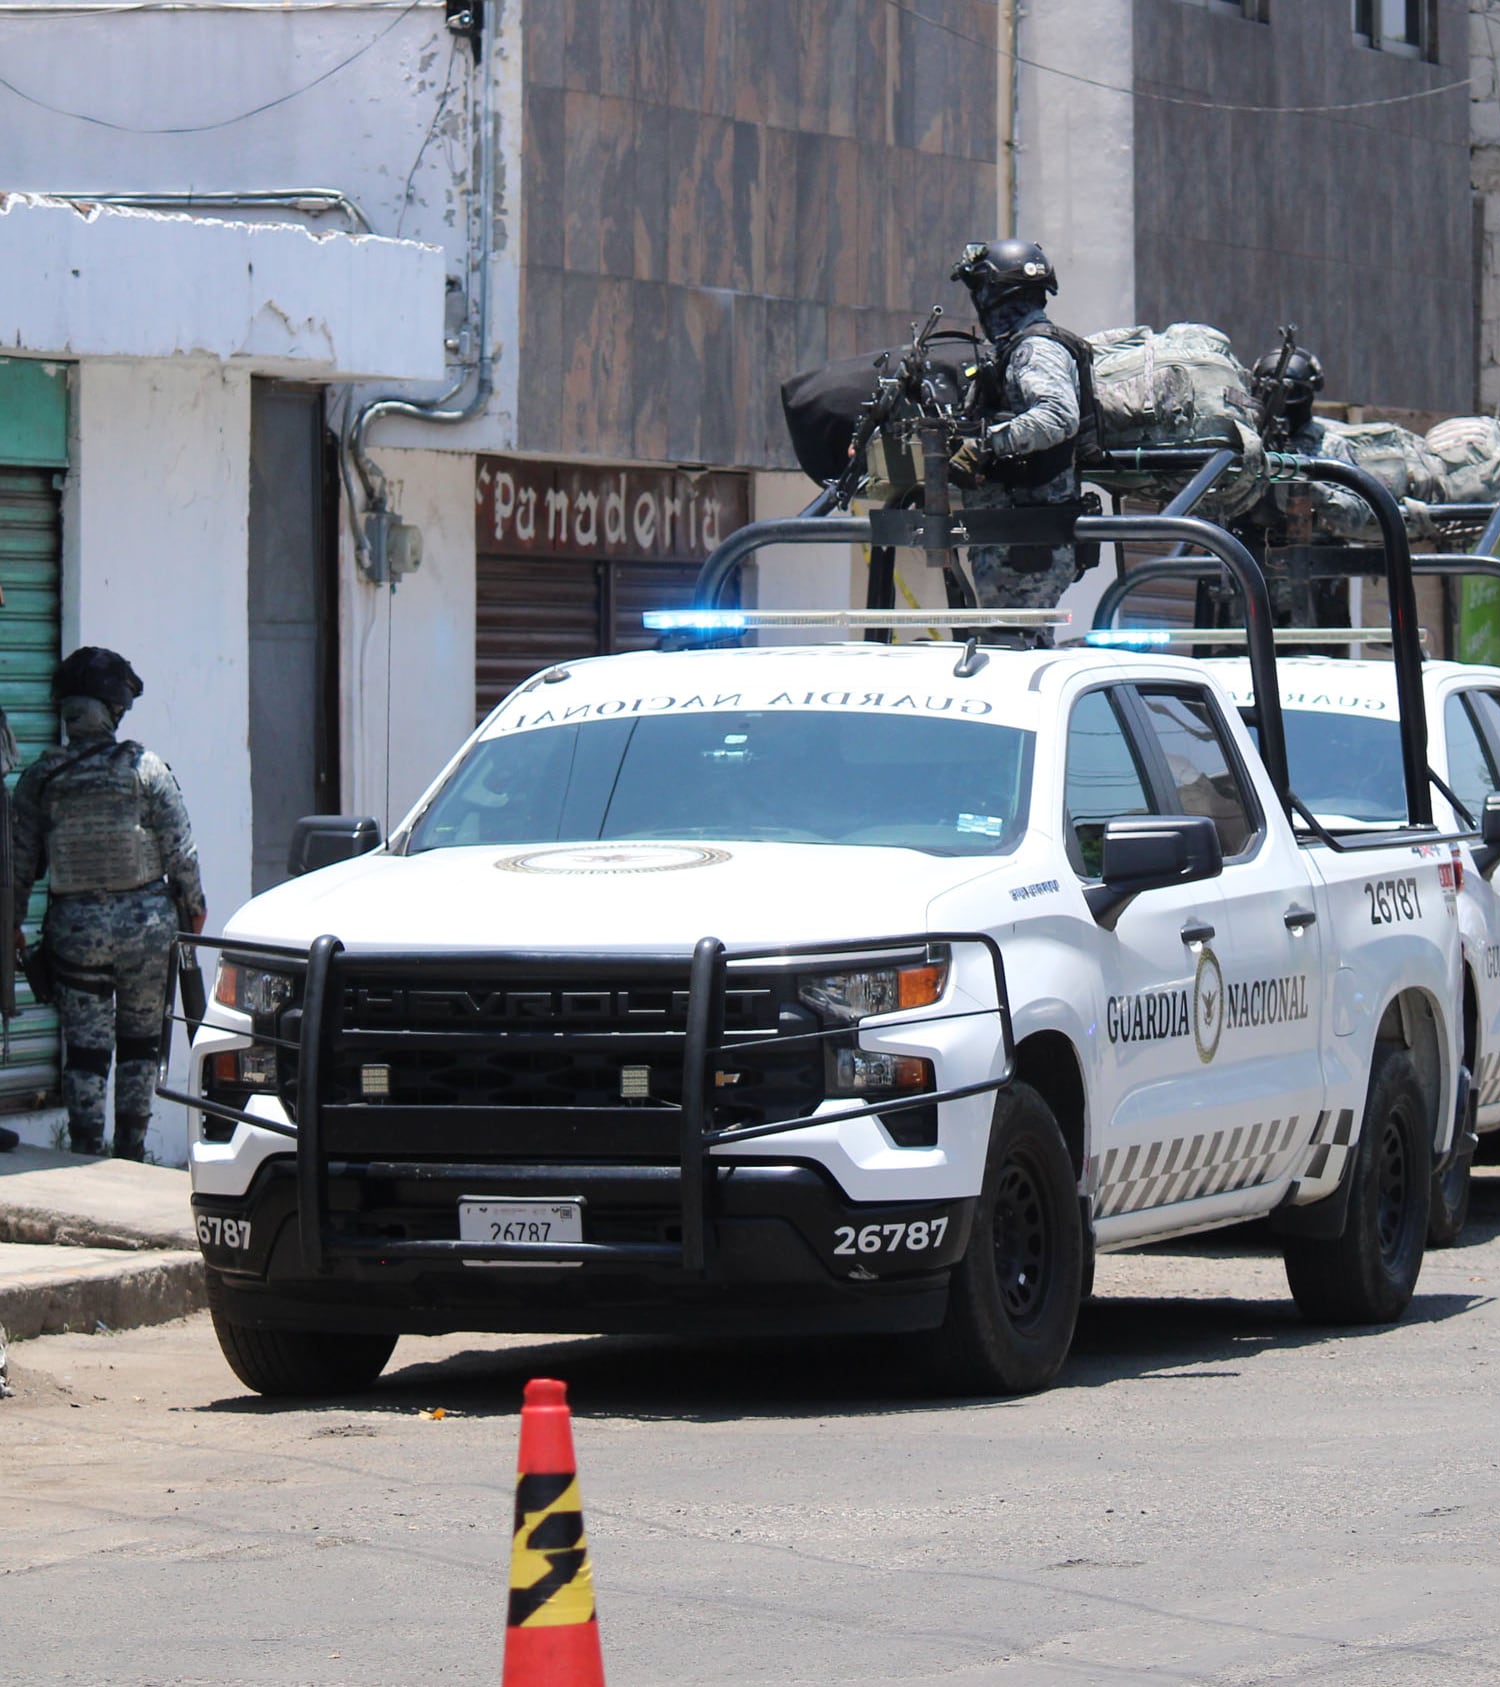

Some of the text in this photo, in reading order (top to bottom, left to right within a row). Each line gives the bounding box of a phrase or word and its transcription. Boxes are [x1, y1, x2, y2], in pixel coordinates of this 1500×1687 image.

[1364, 878, 1422, 925] 26787
[1107, 976, 1308, 1044] GUARDIA NACIONAL
[197, 1214, 252, 1250] 6787
[490, 1222, 552, 1241] 26787
[833, 1217, 949, 1255] 26787
